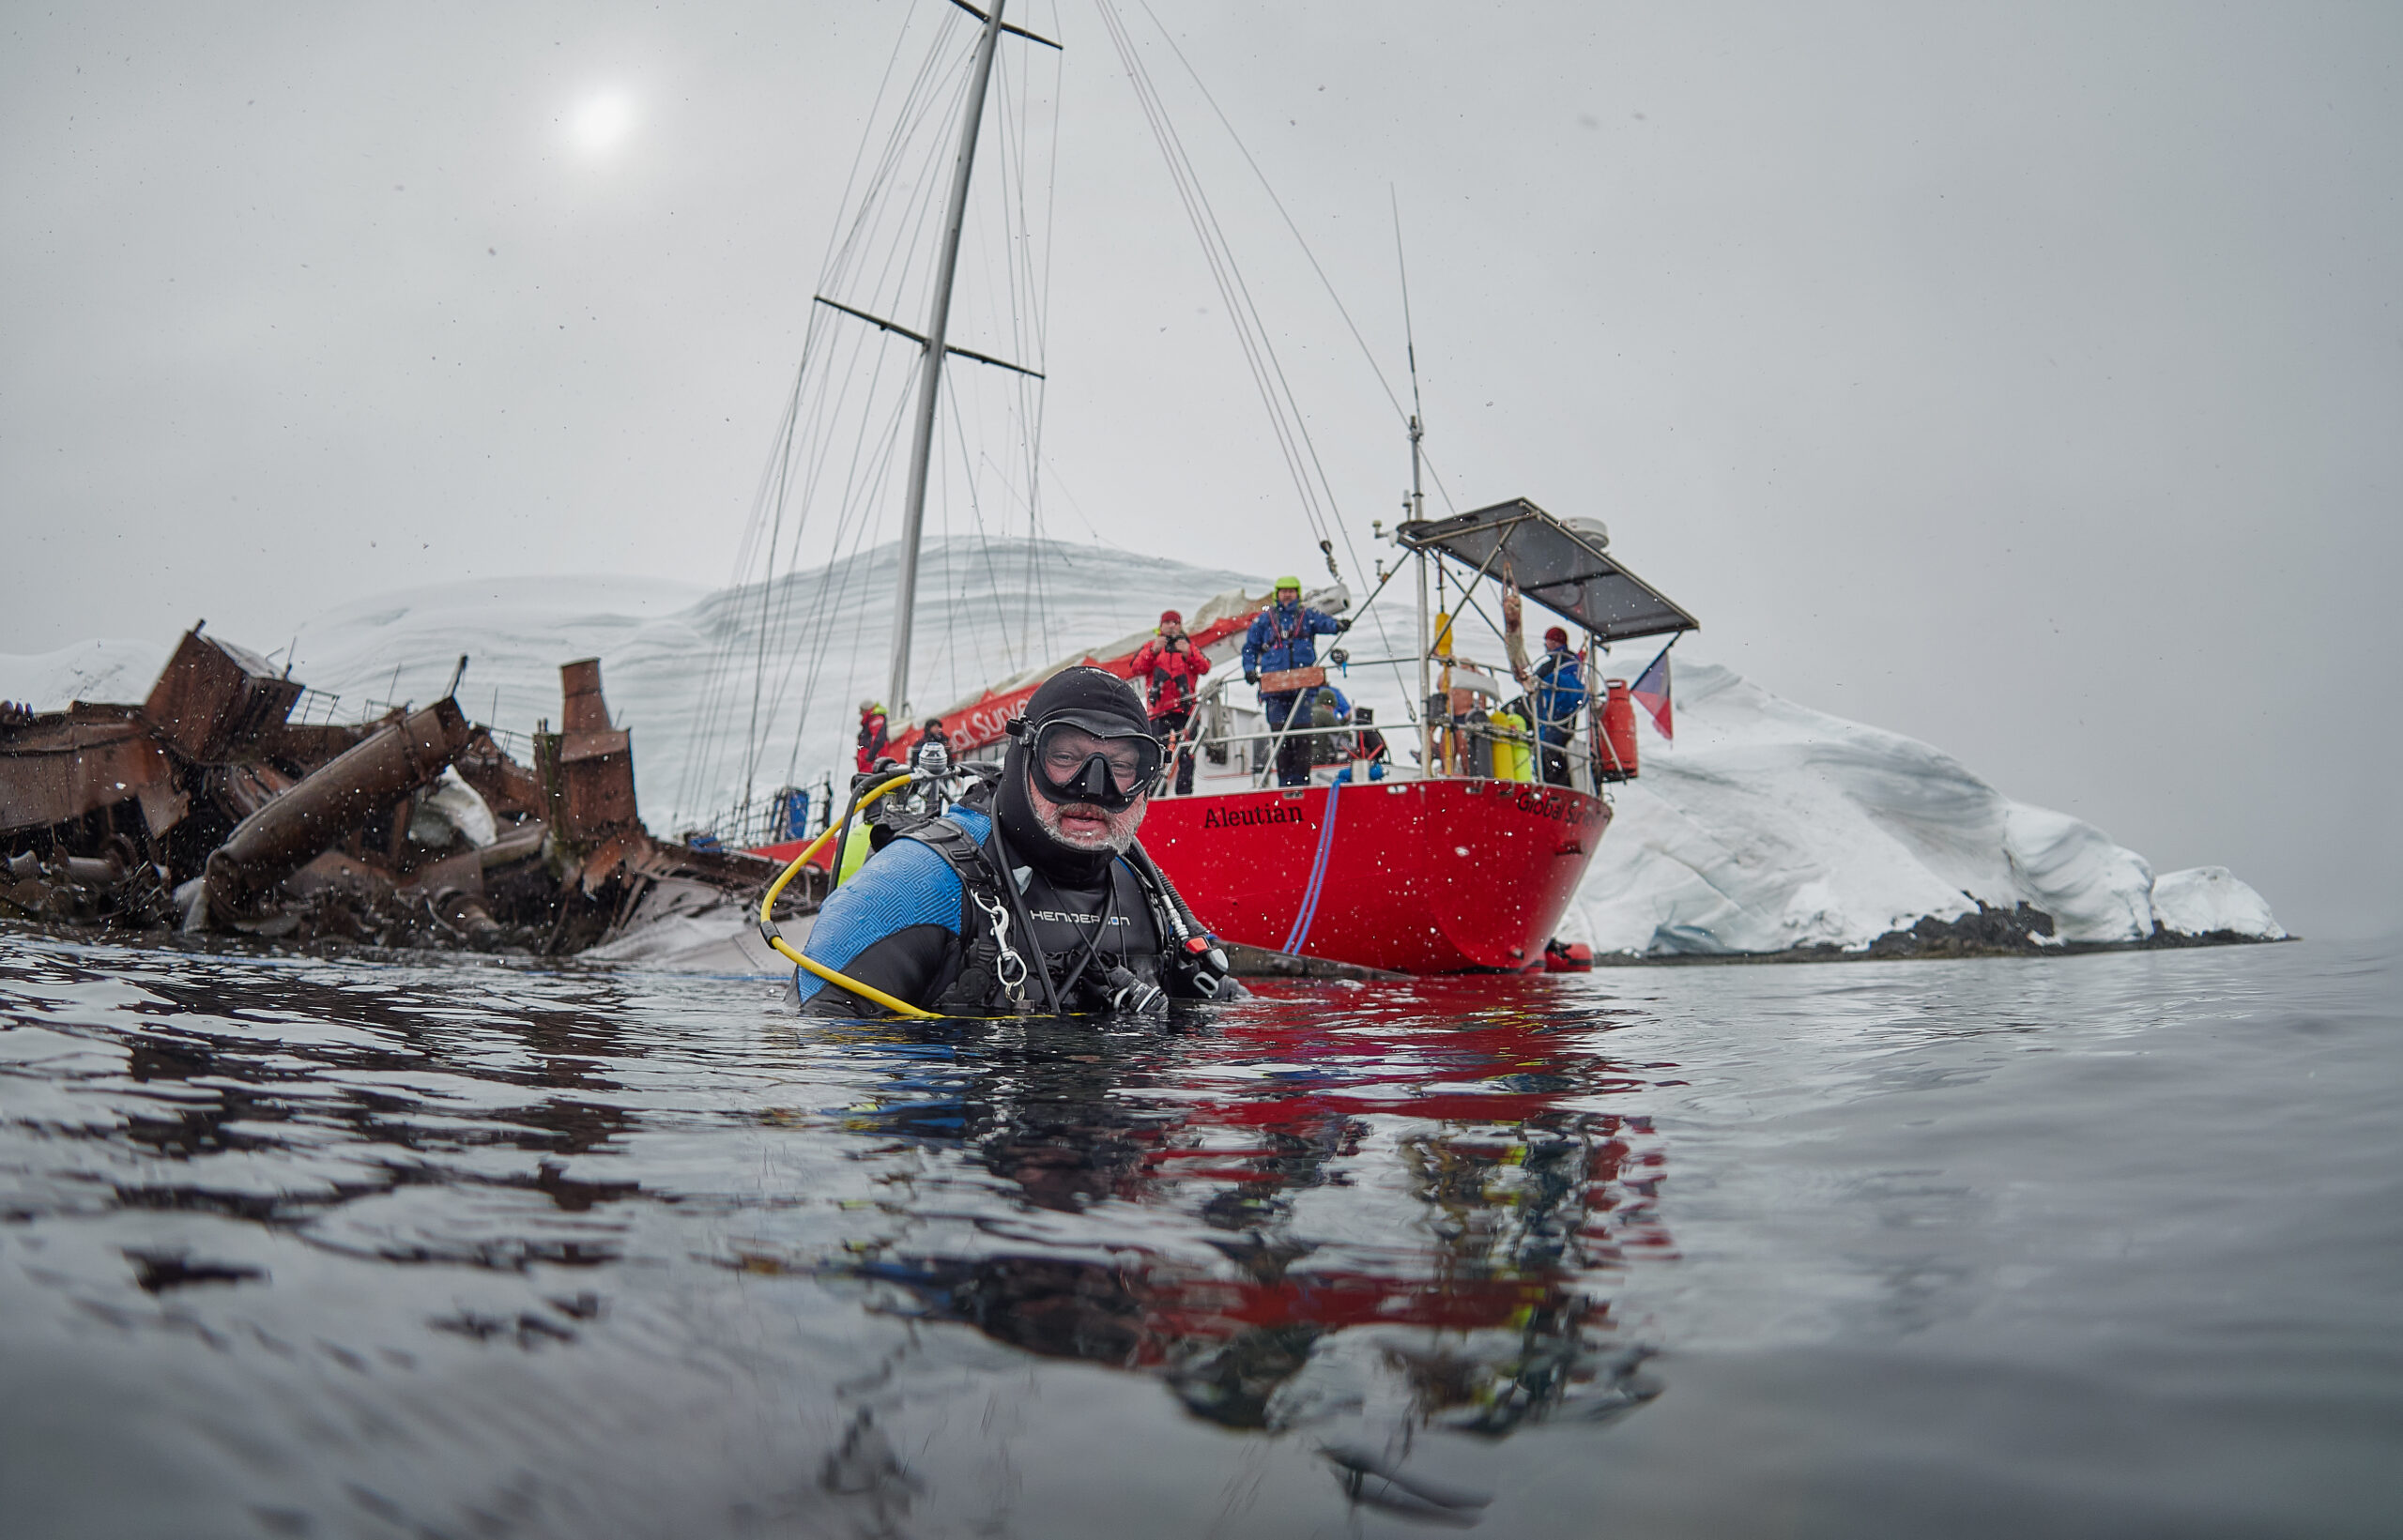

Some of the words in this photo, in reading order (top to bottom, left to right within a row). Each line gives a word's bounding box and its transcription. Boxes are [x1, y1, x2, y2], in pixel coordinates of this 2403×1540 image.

[1204, 803, 1304, 828] Aleutian
[1517, 791, 1566, 821] Global
[1030, 909, 1130, 927] HENDERON
